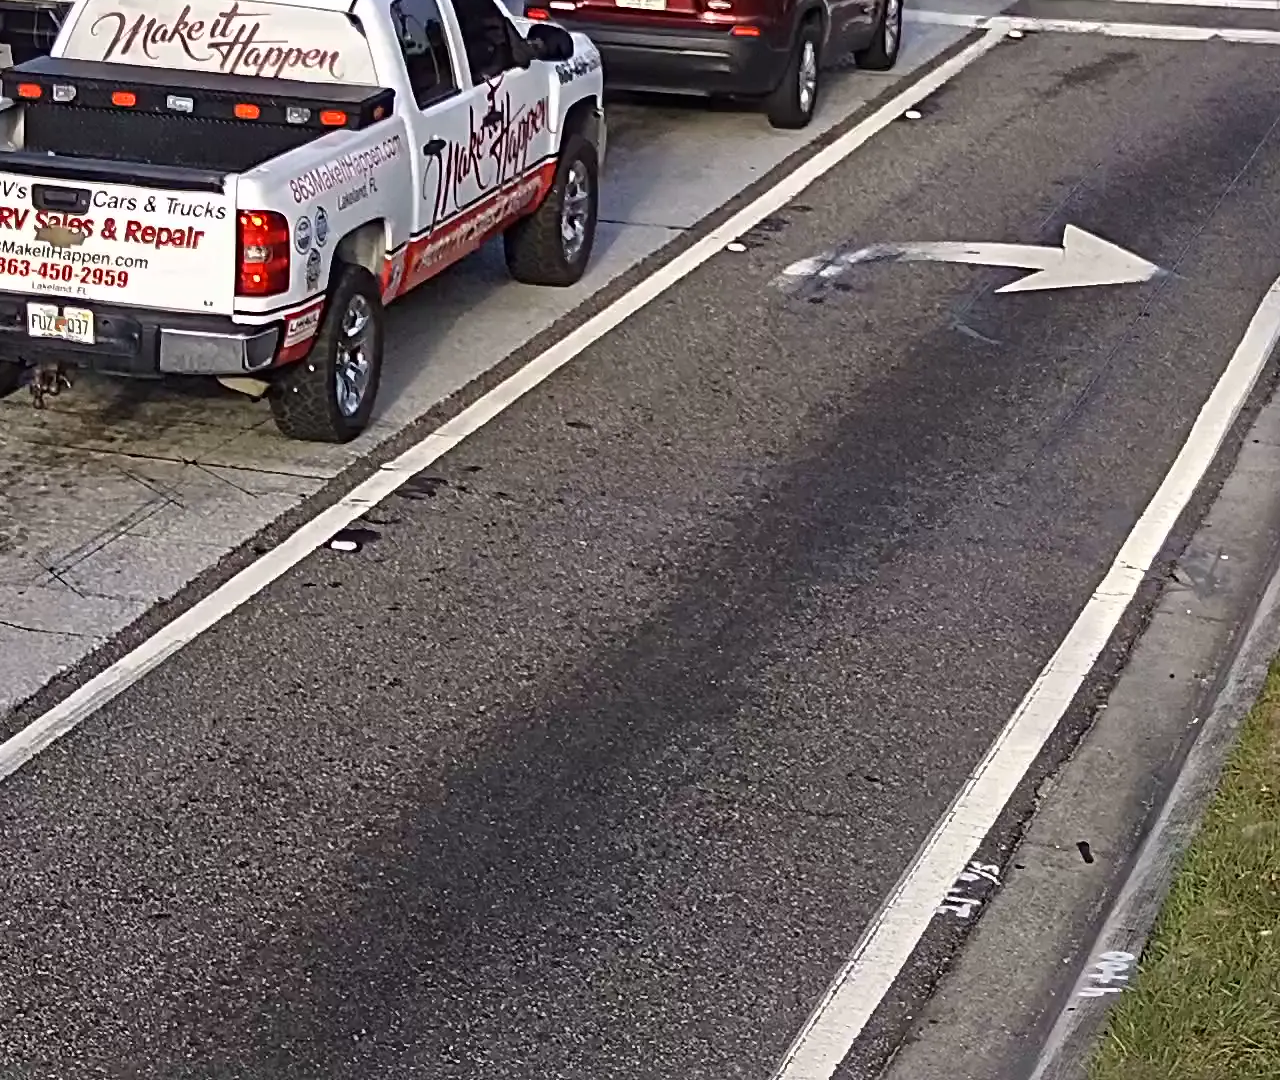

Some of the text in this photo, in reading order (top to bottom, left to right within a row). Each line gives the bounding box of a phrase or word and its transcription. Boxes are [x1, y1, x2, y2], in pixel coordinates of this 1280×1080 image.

[91, 1, 272, 62] Make it
[207, 21, 345, 80] Happen
[93, 191, 137, 211] Cars
[144, 196, 157, 213] &
[167, 197, 226, 220] Trucks
[100, 218, 117, 241] &
[124, 220, 205, 250] Repair
